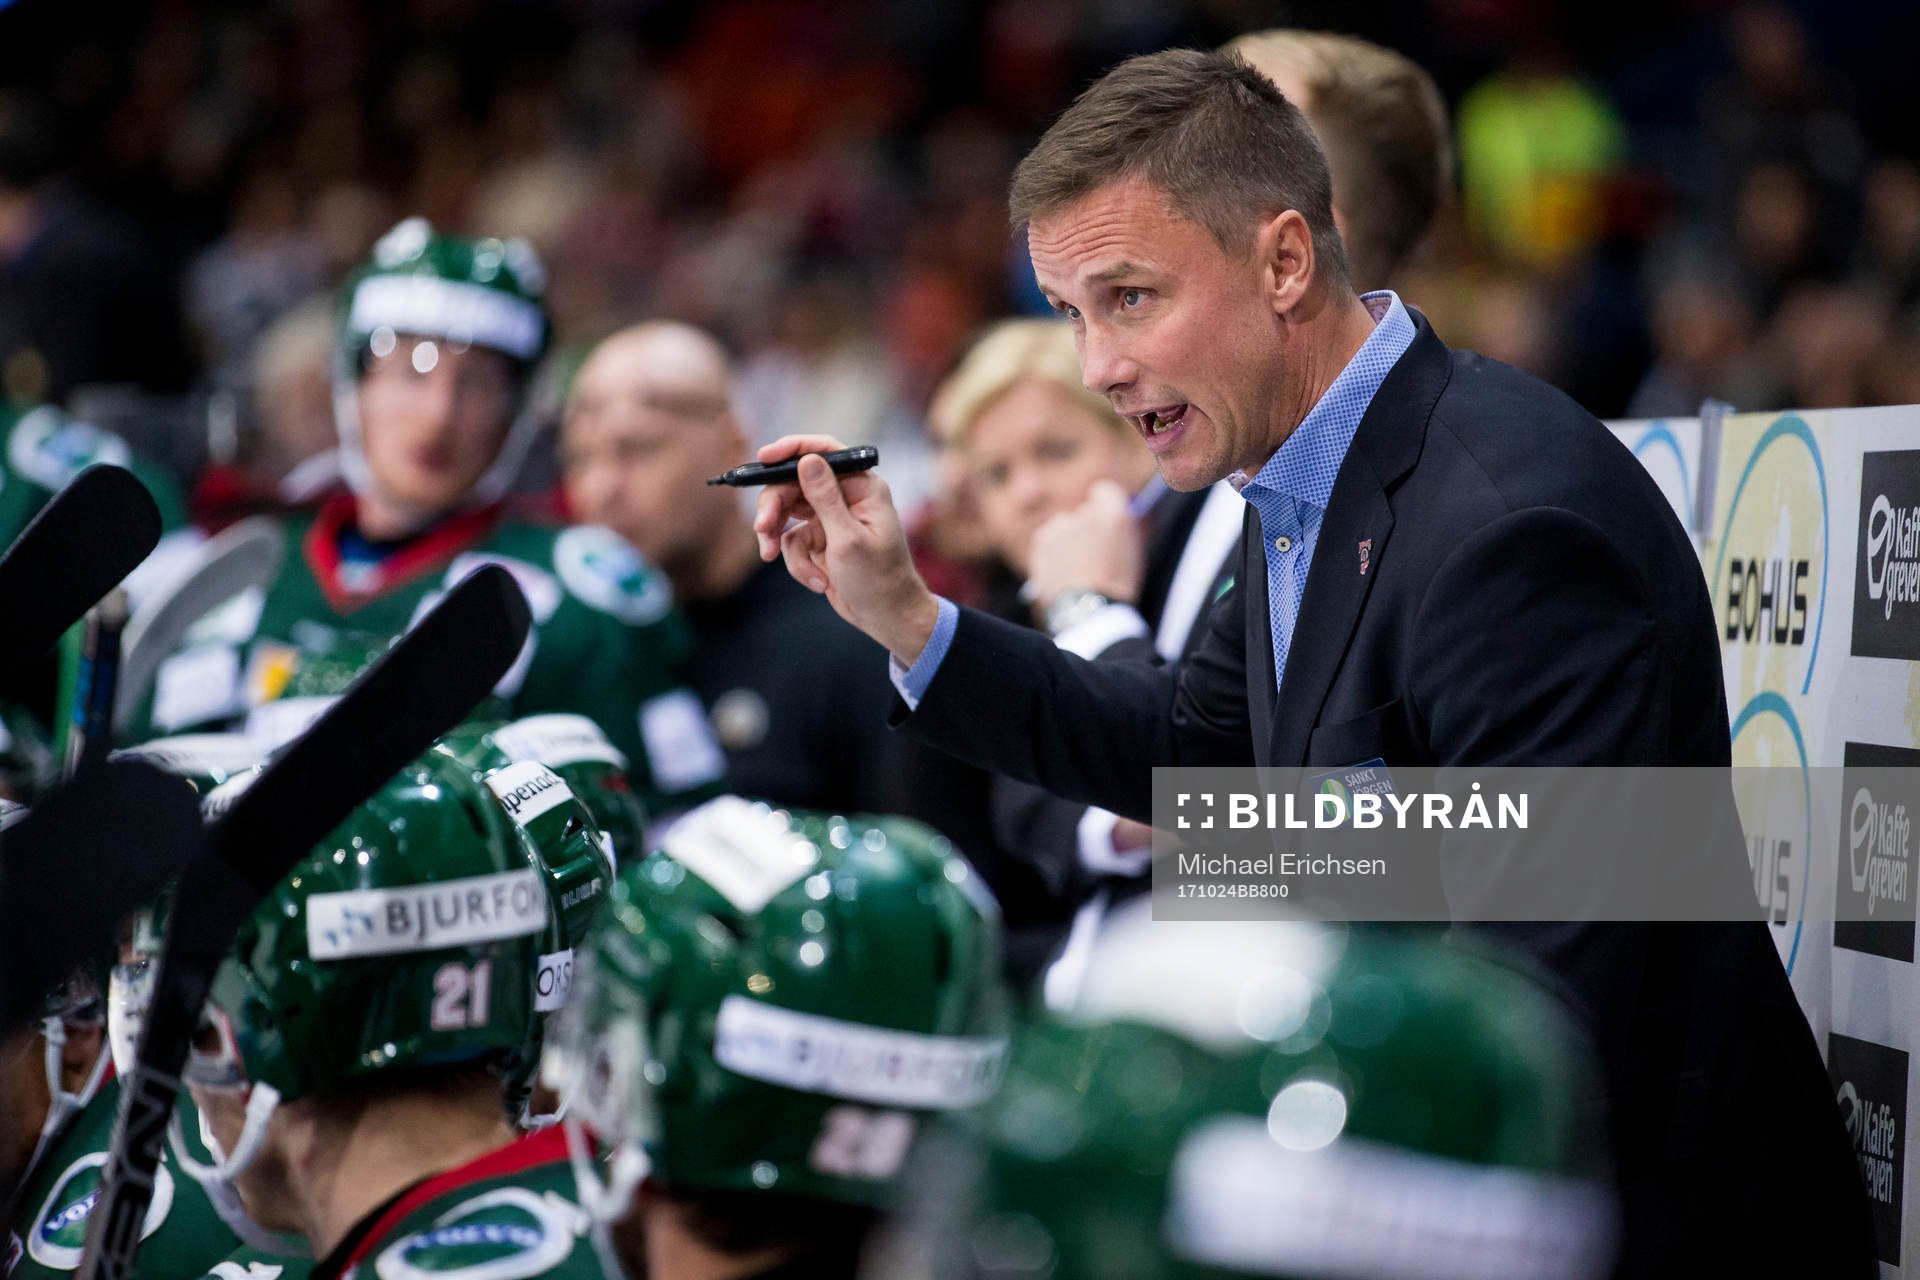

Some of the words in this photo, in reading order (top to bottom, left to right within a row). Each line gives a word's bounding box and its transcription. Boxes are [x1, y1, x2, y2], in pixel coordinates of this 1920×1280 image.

[1726, 558, 1808, 644] BOHUS
[1345, 768, 1377, 787] SANKT
[1878, 803, 1910, 858] Kaffe
[1868, 857, 1907, 915] greven
[431, 959, 491, 1032] 21
[1862, 1100, 1895, 1159] Kaffe
